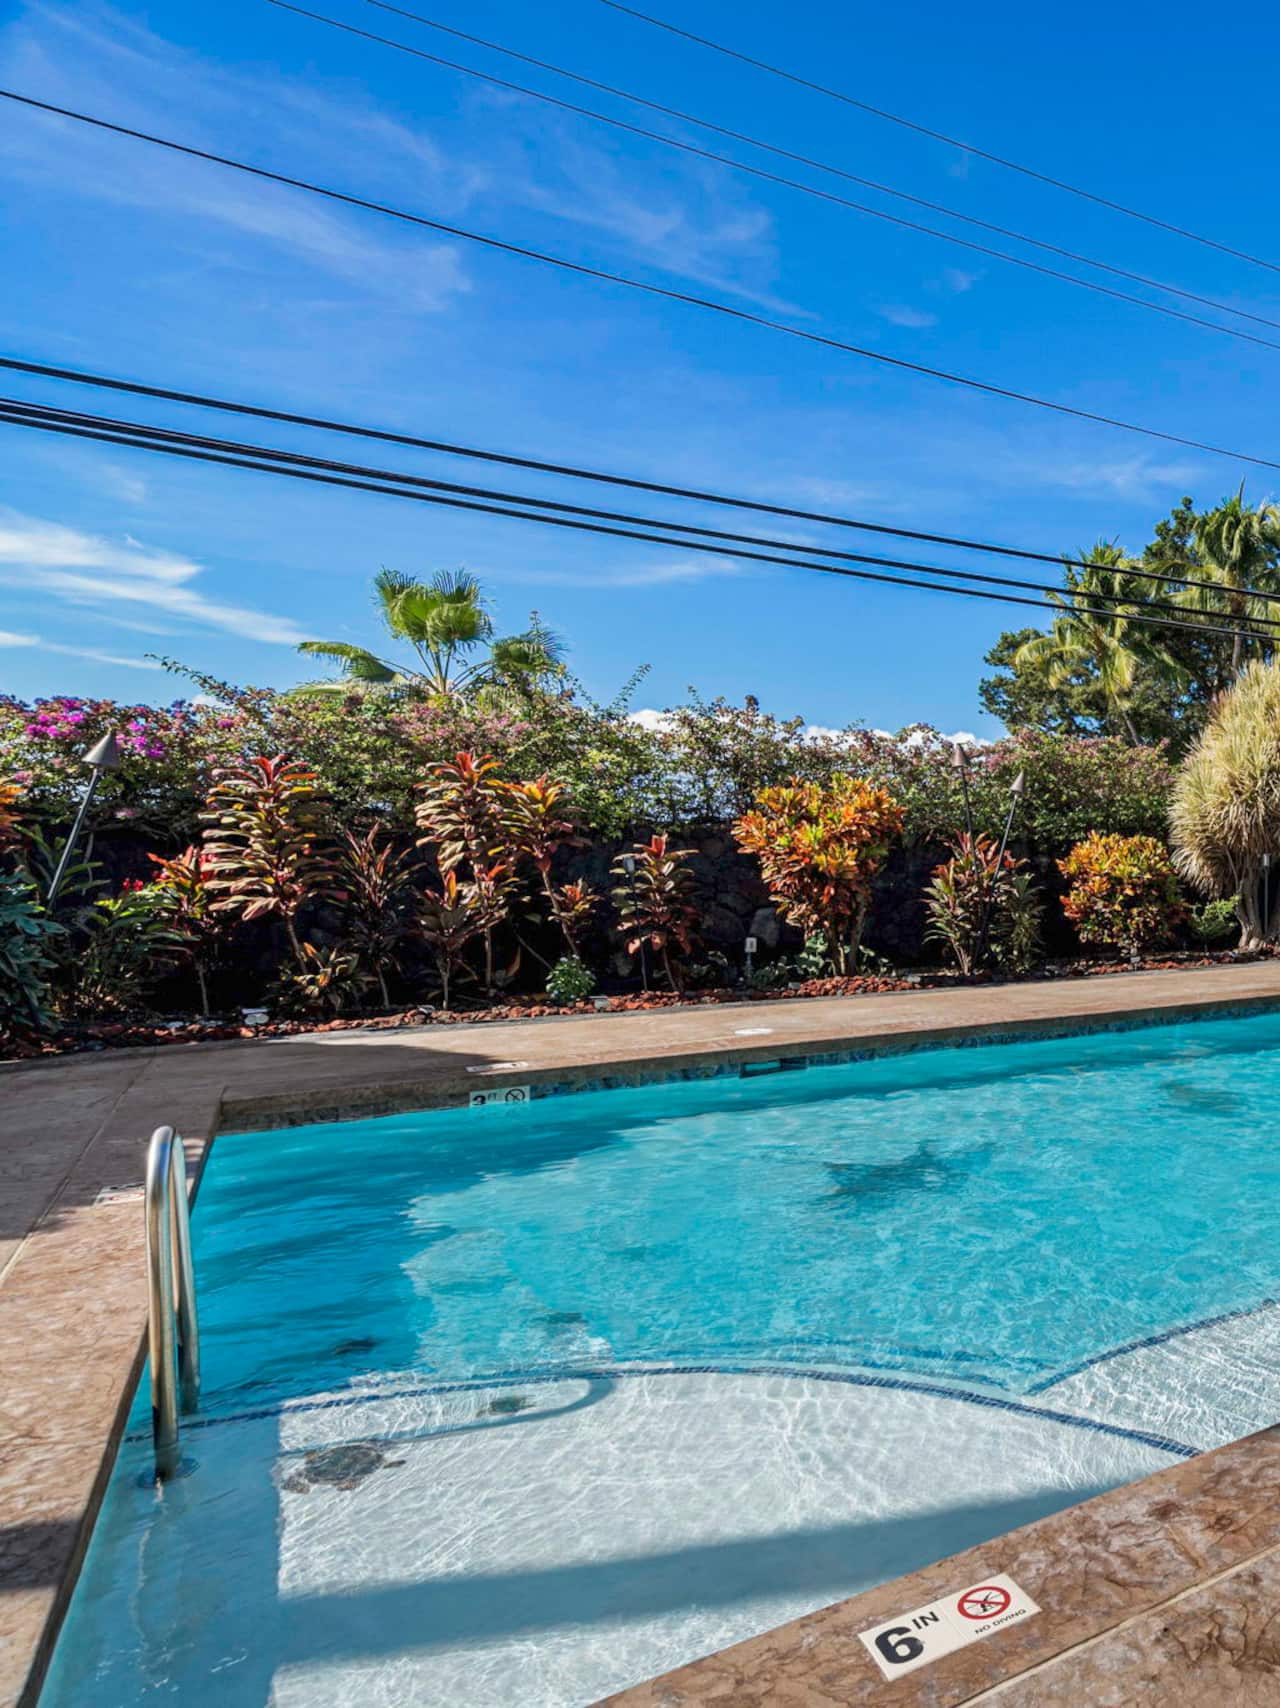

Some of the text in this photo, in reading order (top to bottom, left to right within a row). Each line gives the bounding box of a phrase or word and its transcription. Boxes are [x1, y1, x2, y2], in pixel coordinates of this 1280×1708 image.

[874, 1611, 940, 1665] 6 IN
[975, 1608, 1027, 1635] NO DIVING
